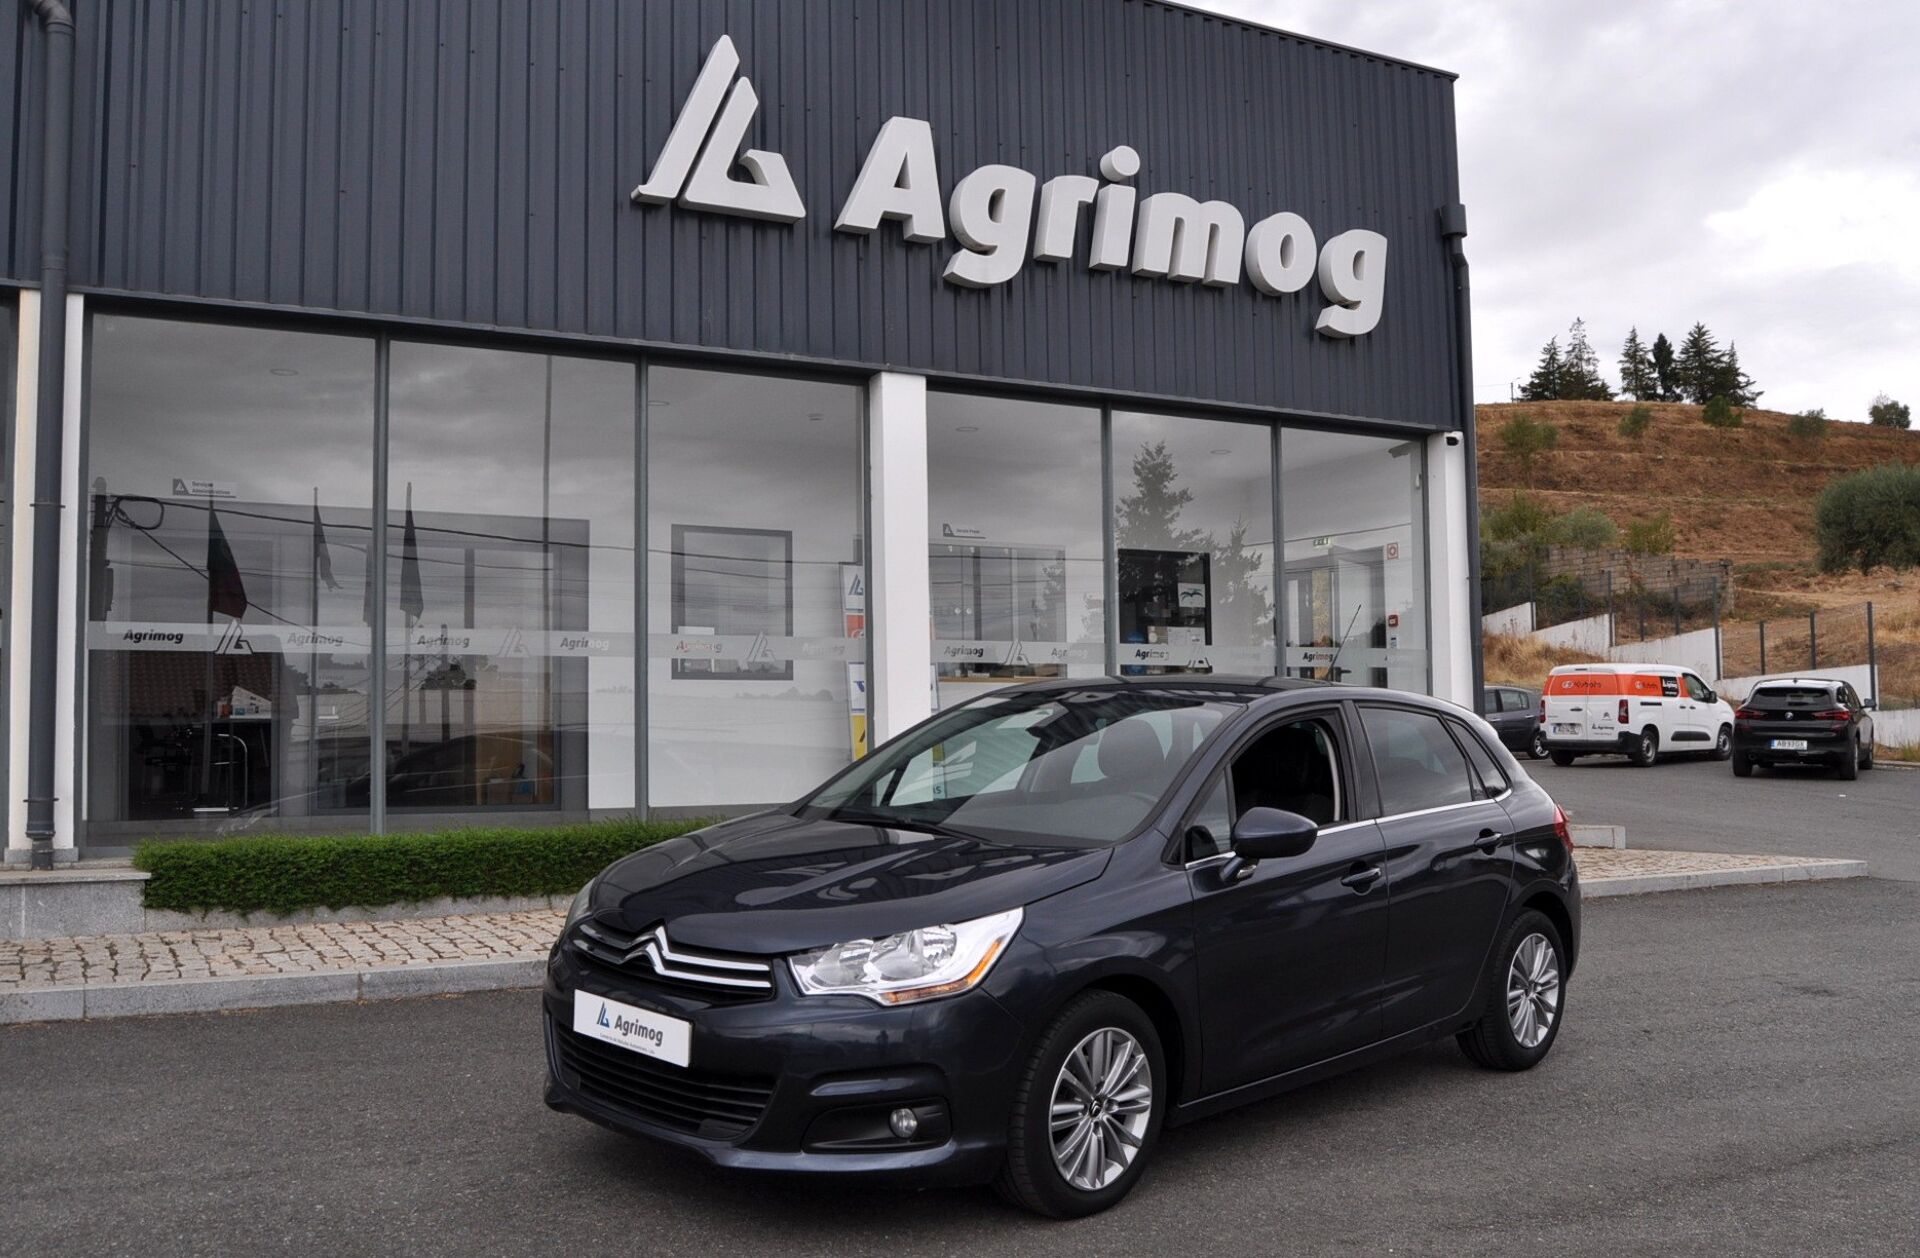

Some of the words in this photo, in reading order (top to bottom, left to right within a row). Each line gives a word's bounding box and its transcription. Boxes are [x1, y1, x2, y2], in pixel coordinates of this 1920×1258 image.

[834, 115, 1388, 339] Agrimog
[123, 628, 184, 644] Agrimog
[287, 631, 344, 647] Agrimog
[417, 633, 470, 648] Agrimog
[559, 635, 609, 651] Agrimog
[676, 640, 722, 653] Agog
[944, 645, 984, 657] Agrimog
[614, 1014, 663, 1047] Agrimog
